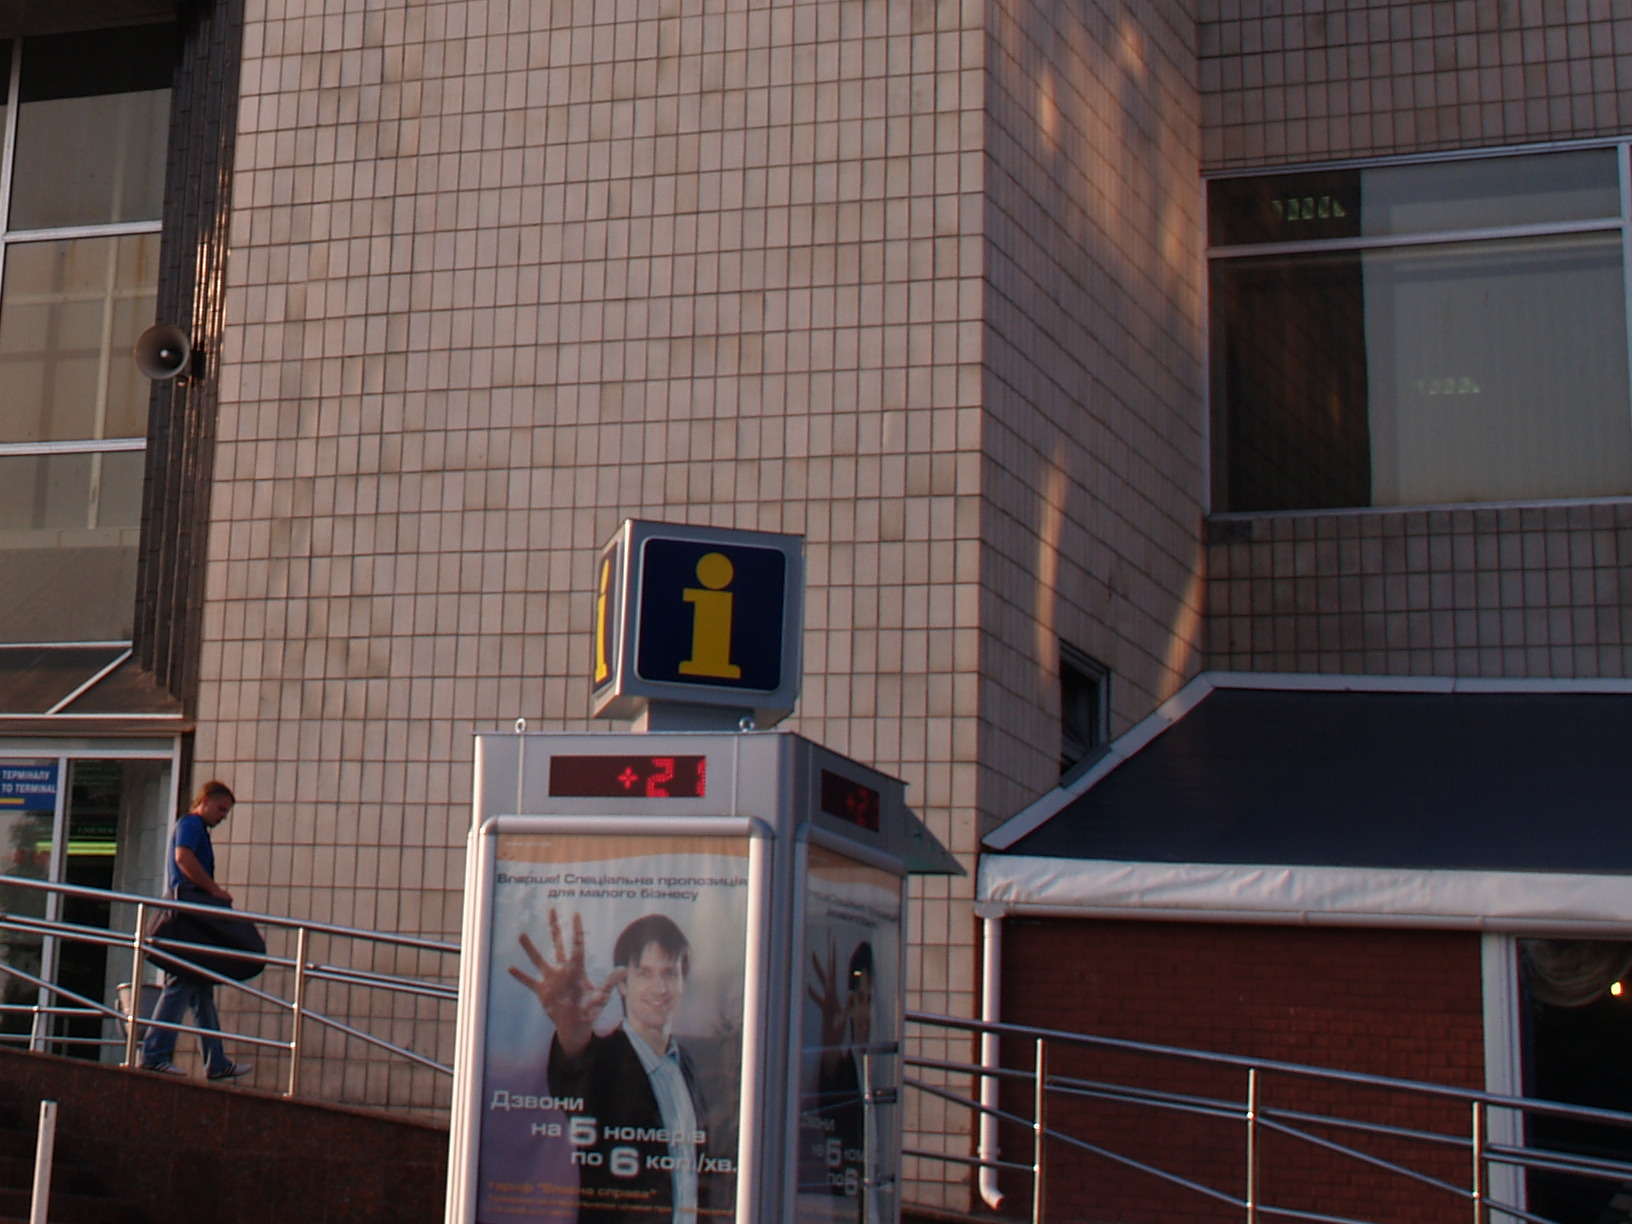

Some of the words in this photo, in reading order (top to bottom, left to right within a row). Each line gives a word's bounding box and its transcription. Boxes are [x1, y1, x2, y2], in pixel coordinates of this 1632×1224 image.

[1, 783, 13, 793] TO
[15, 783, 57, 794] TERMINAL
[497, 873, 560, 886] Вперше!
[563, 873, 654, 886] Спеціальна
[657, 875, 749, 888] пропозиція
[547, 888, 576, 899] для
[578, 888, 636, 899] малого
[640, 887, 699, 902] бізнесу
[490, 1090, 585, 1112] Дзвони
[530, 1122, 562, 1137] на
[569, 1116, 598, 1147] 5
[603, 1126, 707, 1146] номерів
[570, 1150, 603, 1166] по
[610, 1146, 640, 1177] 6
